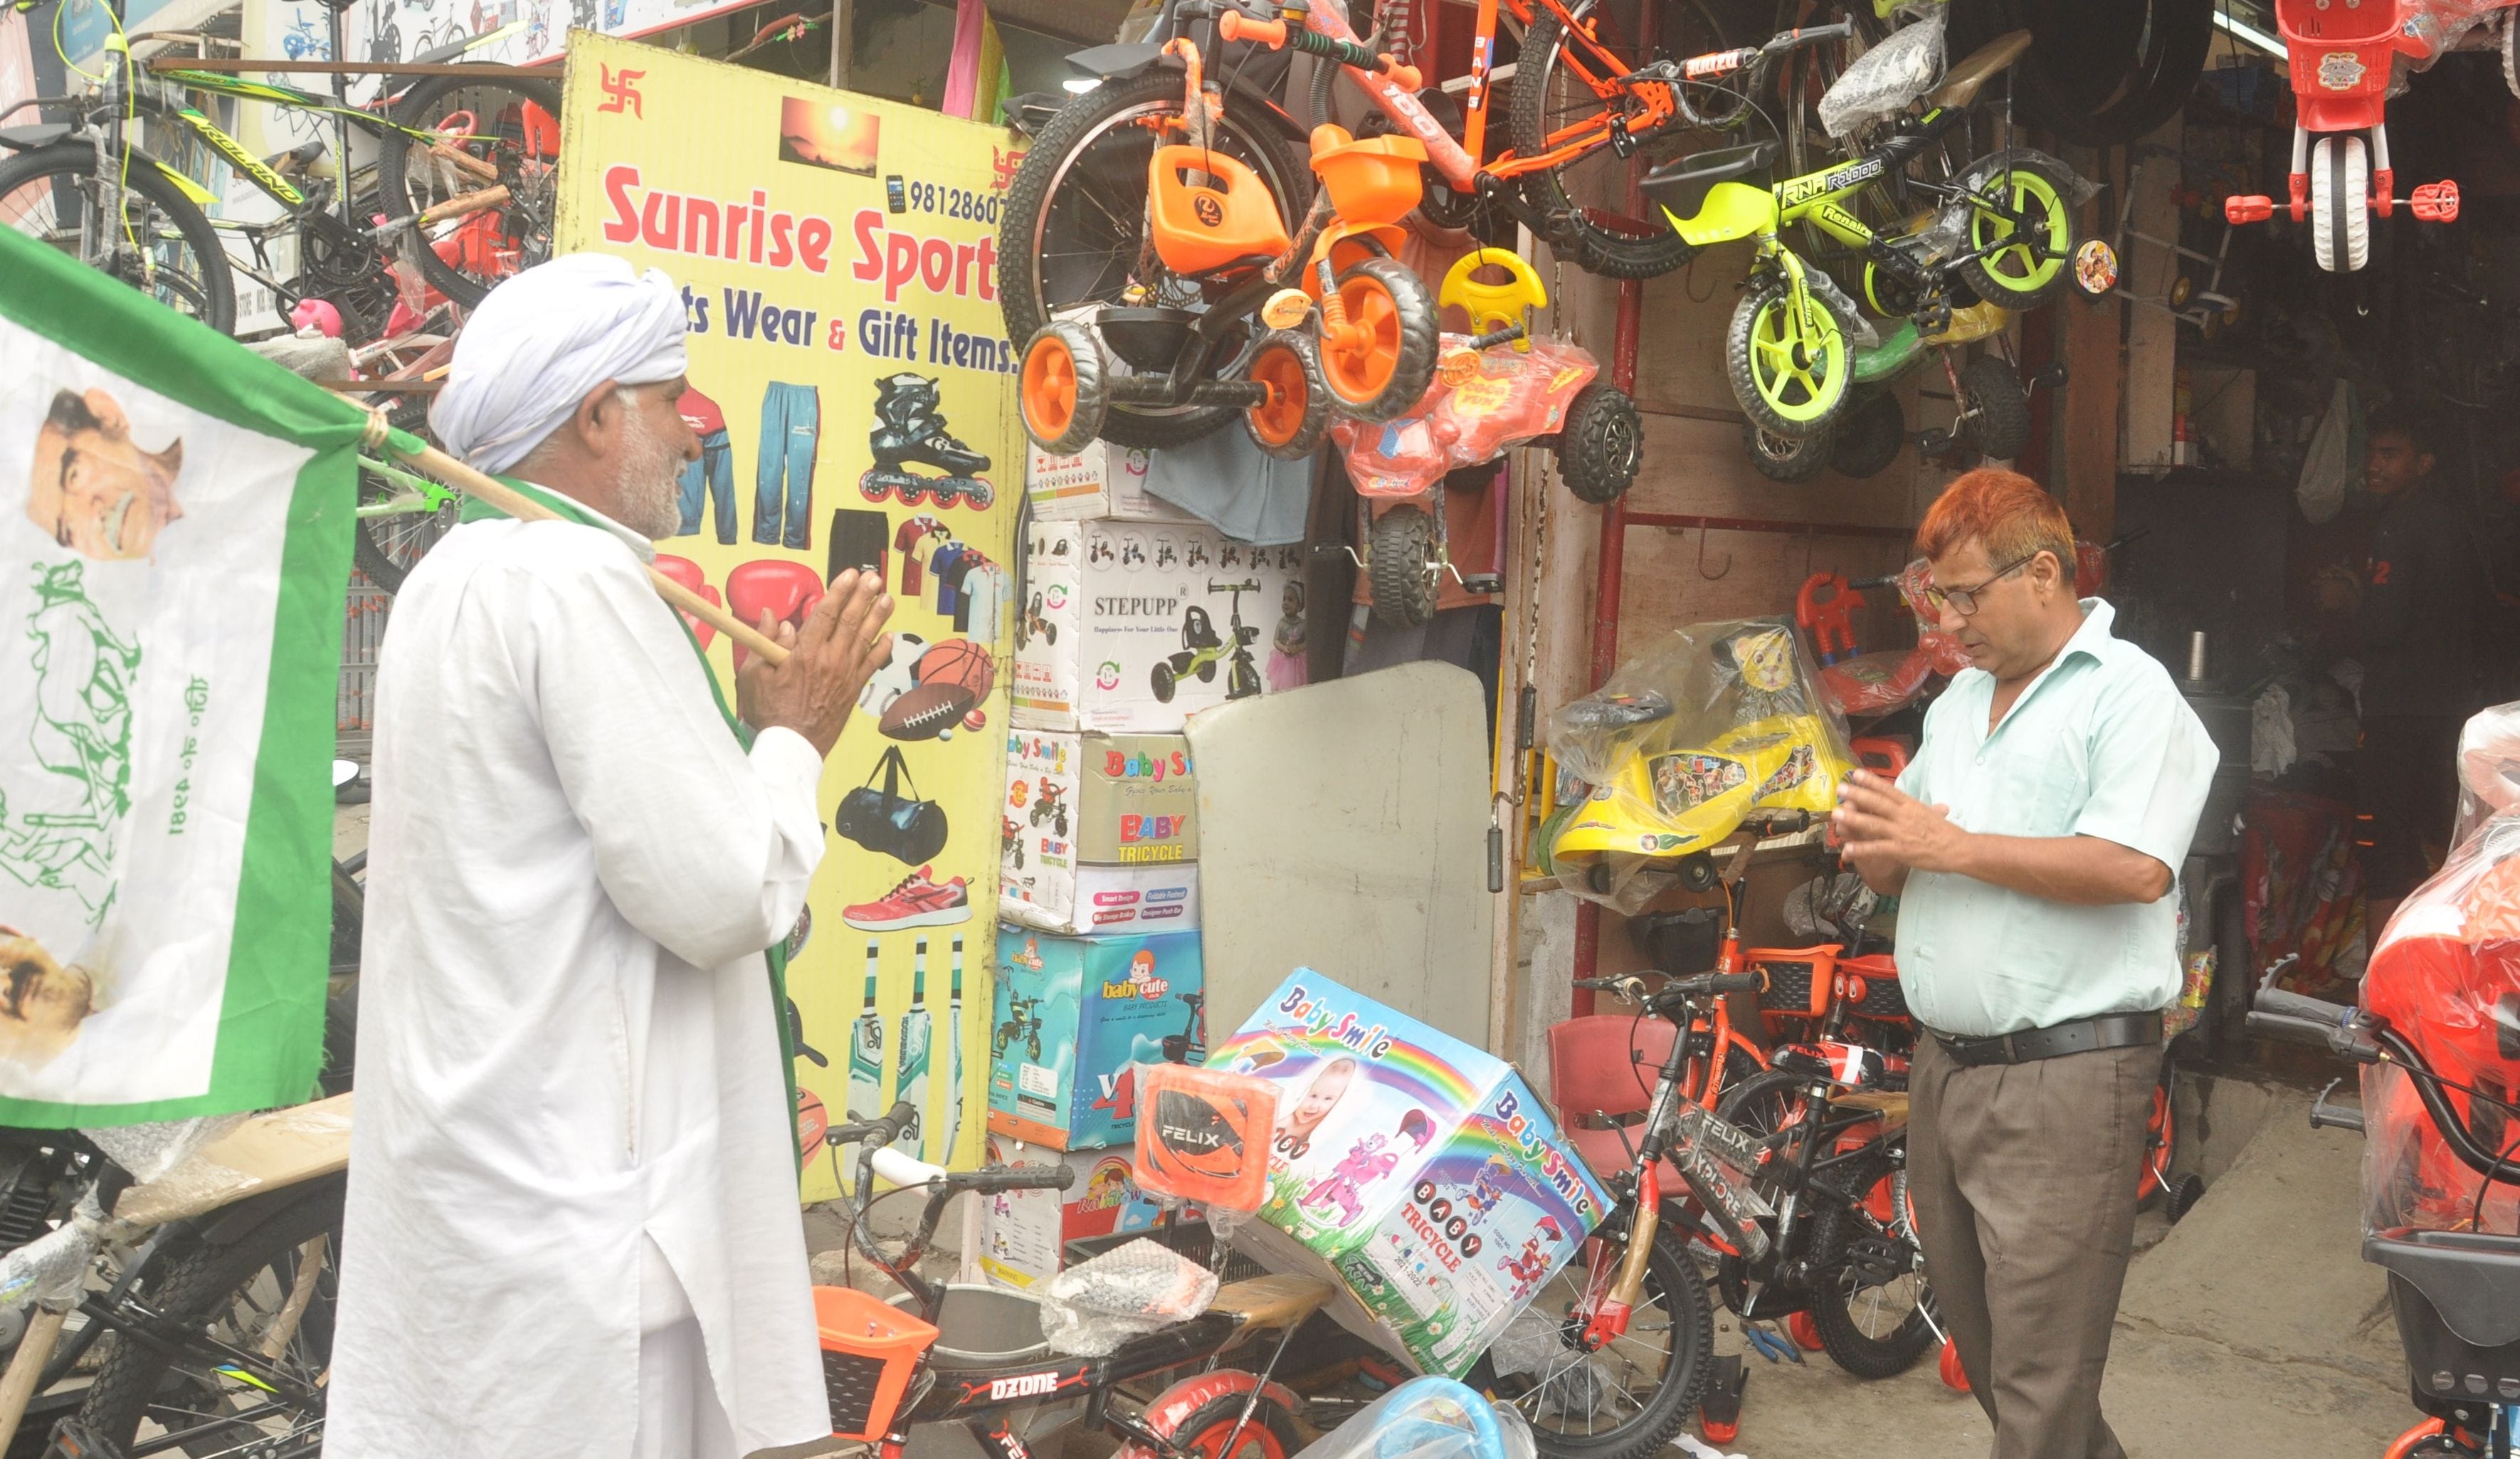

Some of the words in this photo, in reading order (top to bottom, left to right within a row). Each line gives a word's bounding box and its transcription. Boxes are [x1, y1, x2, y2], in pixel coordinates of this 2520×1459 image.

[1468, 36, 1485, 108] BANG
[197, 124, 303, 204] ROLAND
[603, 165, 832, 273] Sunrise
[853, 210, 1002, 302] Sport
[724, 288, 816, 346] Wear
[828, 320, 845, 350] &
[858, 309, 918, 361] Gift
[929, 317, 1018, 374] Items.
[1095, 597, 1177, 616] STEPUPP
[1008, 734, 1030, 759] aby
[1033, 738, 1066, 762] Smile
[1105, 750, 1166, 782] Baby
[1120, 813, 1186, 843] BABY
[1041, 838, 1068, 854] BABY
[1119, 845, 1183, 862] TRICYCLE
[1280, 986, 1333, 1038] Baby
[1330, 1011, 1393, 1060] Smile
[1788, 1045, 1825, 1058] FELIX
[1162, 1125, 1220, 1147] FELIX
[1702, 1115, 1751, 1152] FELIX
[1494, 1090, 1546, 1162] Baby
[1542, 1145, 1591, 1217] Smile
[1697, 1152, 1742, 1216] XPLORE
[1415, 1181, 1480, 1255] BABY
[1401, 1202, 1462, 1274] TRICYCLE
[1394, 1256, 1423, 1287] 2021-2022
[991, 1371, 1059, 1400] OZONE
[1000, 1433, 1027, 1459] FE
